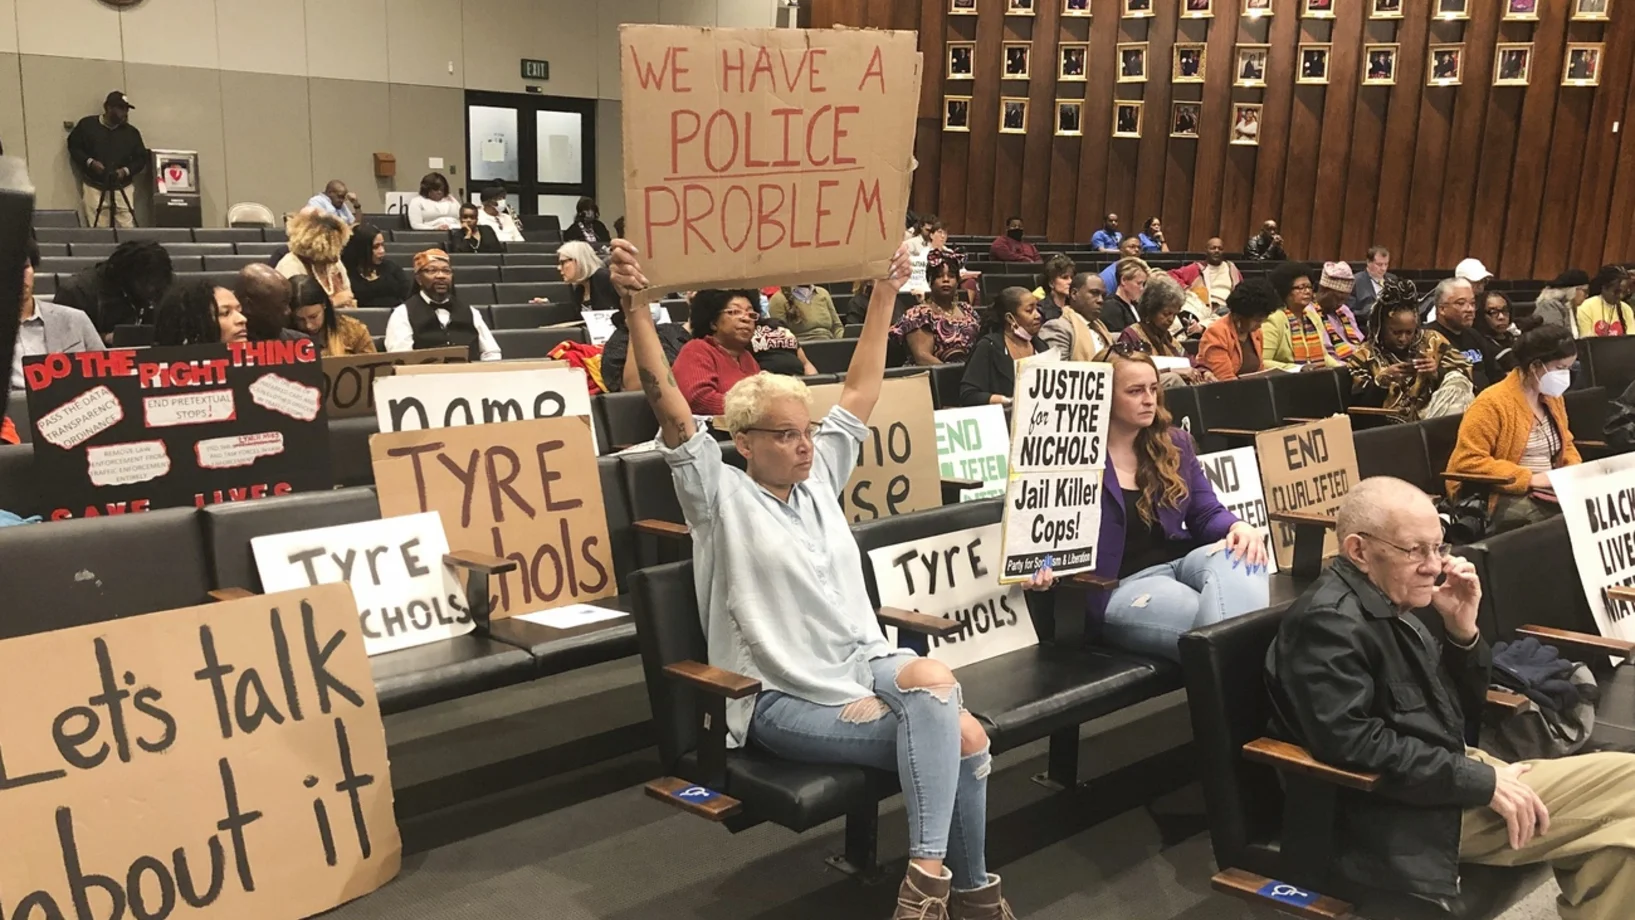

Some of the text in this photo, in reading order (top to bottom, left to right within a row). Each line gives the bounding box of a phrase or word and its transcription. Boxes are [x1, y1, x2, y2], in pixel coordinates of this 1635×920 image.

[527, 61, 545, 77] EXIT
[630, 45, 885, 94] WE HAVE A
[671, 104, 860, 174] POLICE
[644, 178, 887, 259] PROBLEM
[24, 338, 317, 391] DO THE RIGHT THING
[1028, 368, 1105, 401] JUSTICE
[38, 388, 109, 429] PASS THE DATA
[46, 398, 117, 441] TRANSPARENCY
[148, 394, 231, 408] END PRETEXTUAL
[1028, 401, 1099, 436] for TYRE
[63, 414, 116, 447] ORDINANCE
[1020, 435, 1100, 467] NICHOLS
[1283, 428, 1329, 471] END
[387, 439, 583, 528] TYRE
[1015, 478, 1050, 510] Jail
[1054, 477, 1098, 508] Killer
[1200, 455, 1239, 493] ND
[1272, 469, 1349, 512] QUALIFIED
[838, 474, 914, 522] se
[1031, 511, 1081, 548] Cops!
[489, 518, 608, 612] hols
[893, 538, 988, 595] TyrE
[1007, 559, 1024, 573] Party
[1024, 557, 1034, 569] for
[1062, 554, 1067, 566] &
[1068, 552, 1091, 565] Liberation
[1598, 532, 1635, 576] LIVE
[360, 593, 471, 639] CHOLS
[194, 598, 365, 739] talk
[302, 717, 374, 867] it
